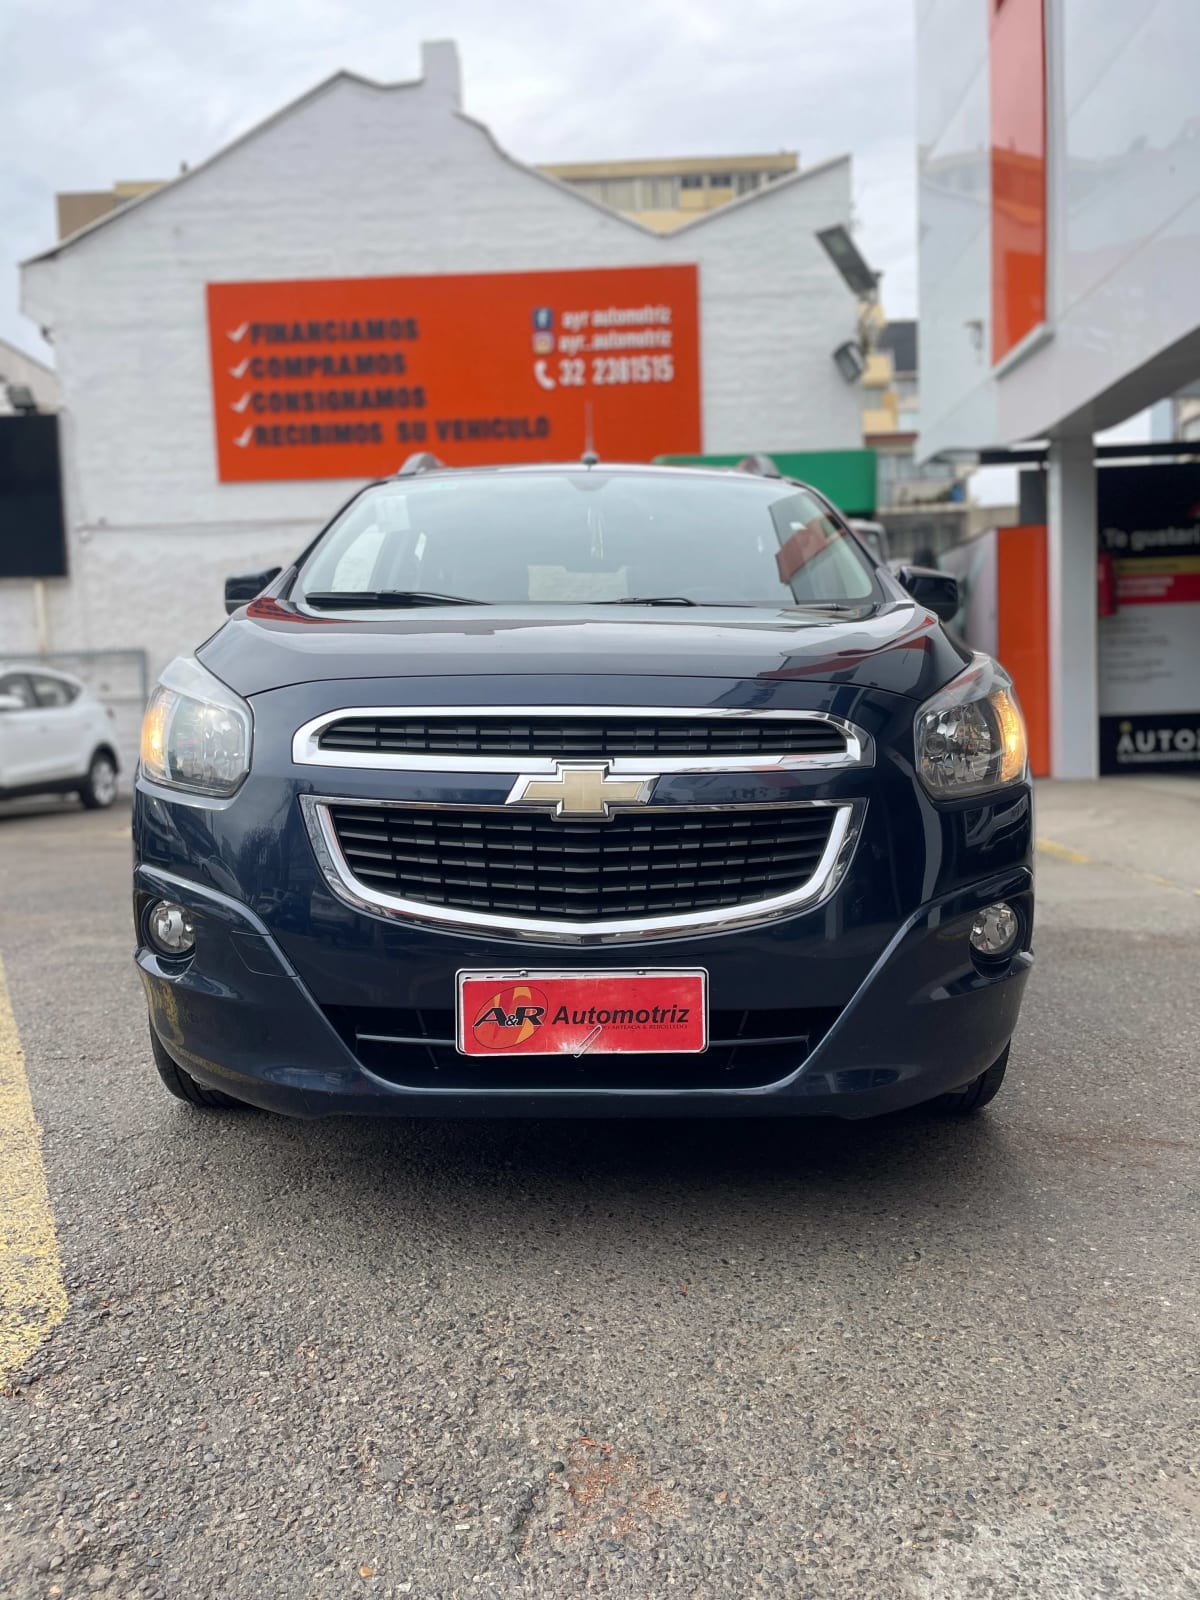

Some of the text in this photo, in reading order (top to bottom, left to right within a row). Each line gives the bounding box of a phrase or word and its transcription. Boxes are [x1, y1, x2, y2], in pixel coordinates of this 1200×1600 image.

[251, 317, 419, 345] FINANCIAMOS
[561, 304, 672, 332] ayr automotriz
[251, 351, 406, 380] COMPRAMOS
[558, 358, 586, 386] 32
[251, 386, 426, 414] CONSIGNAMOS
[255, 415, 550, 447] RECIBIMOS SU VEHICULO
[473, 1004, 690, 1027] A&R Automotriz
